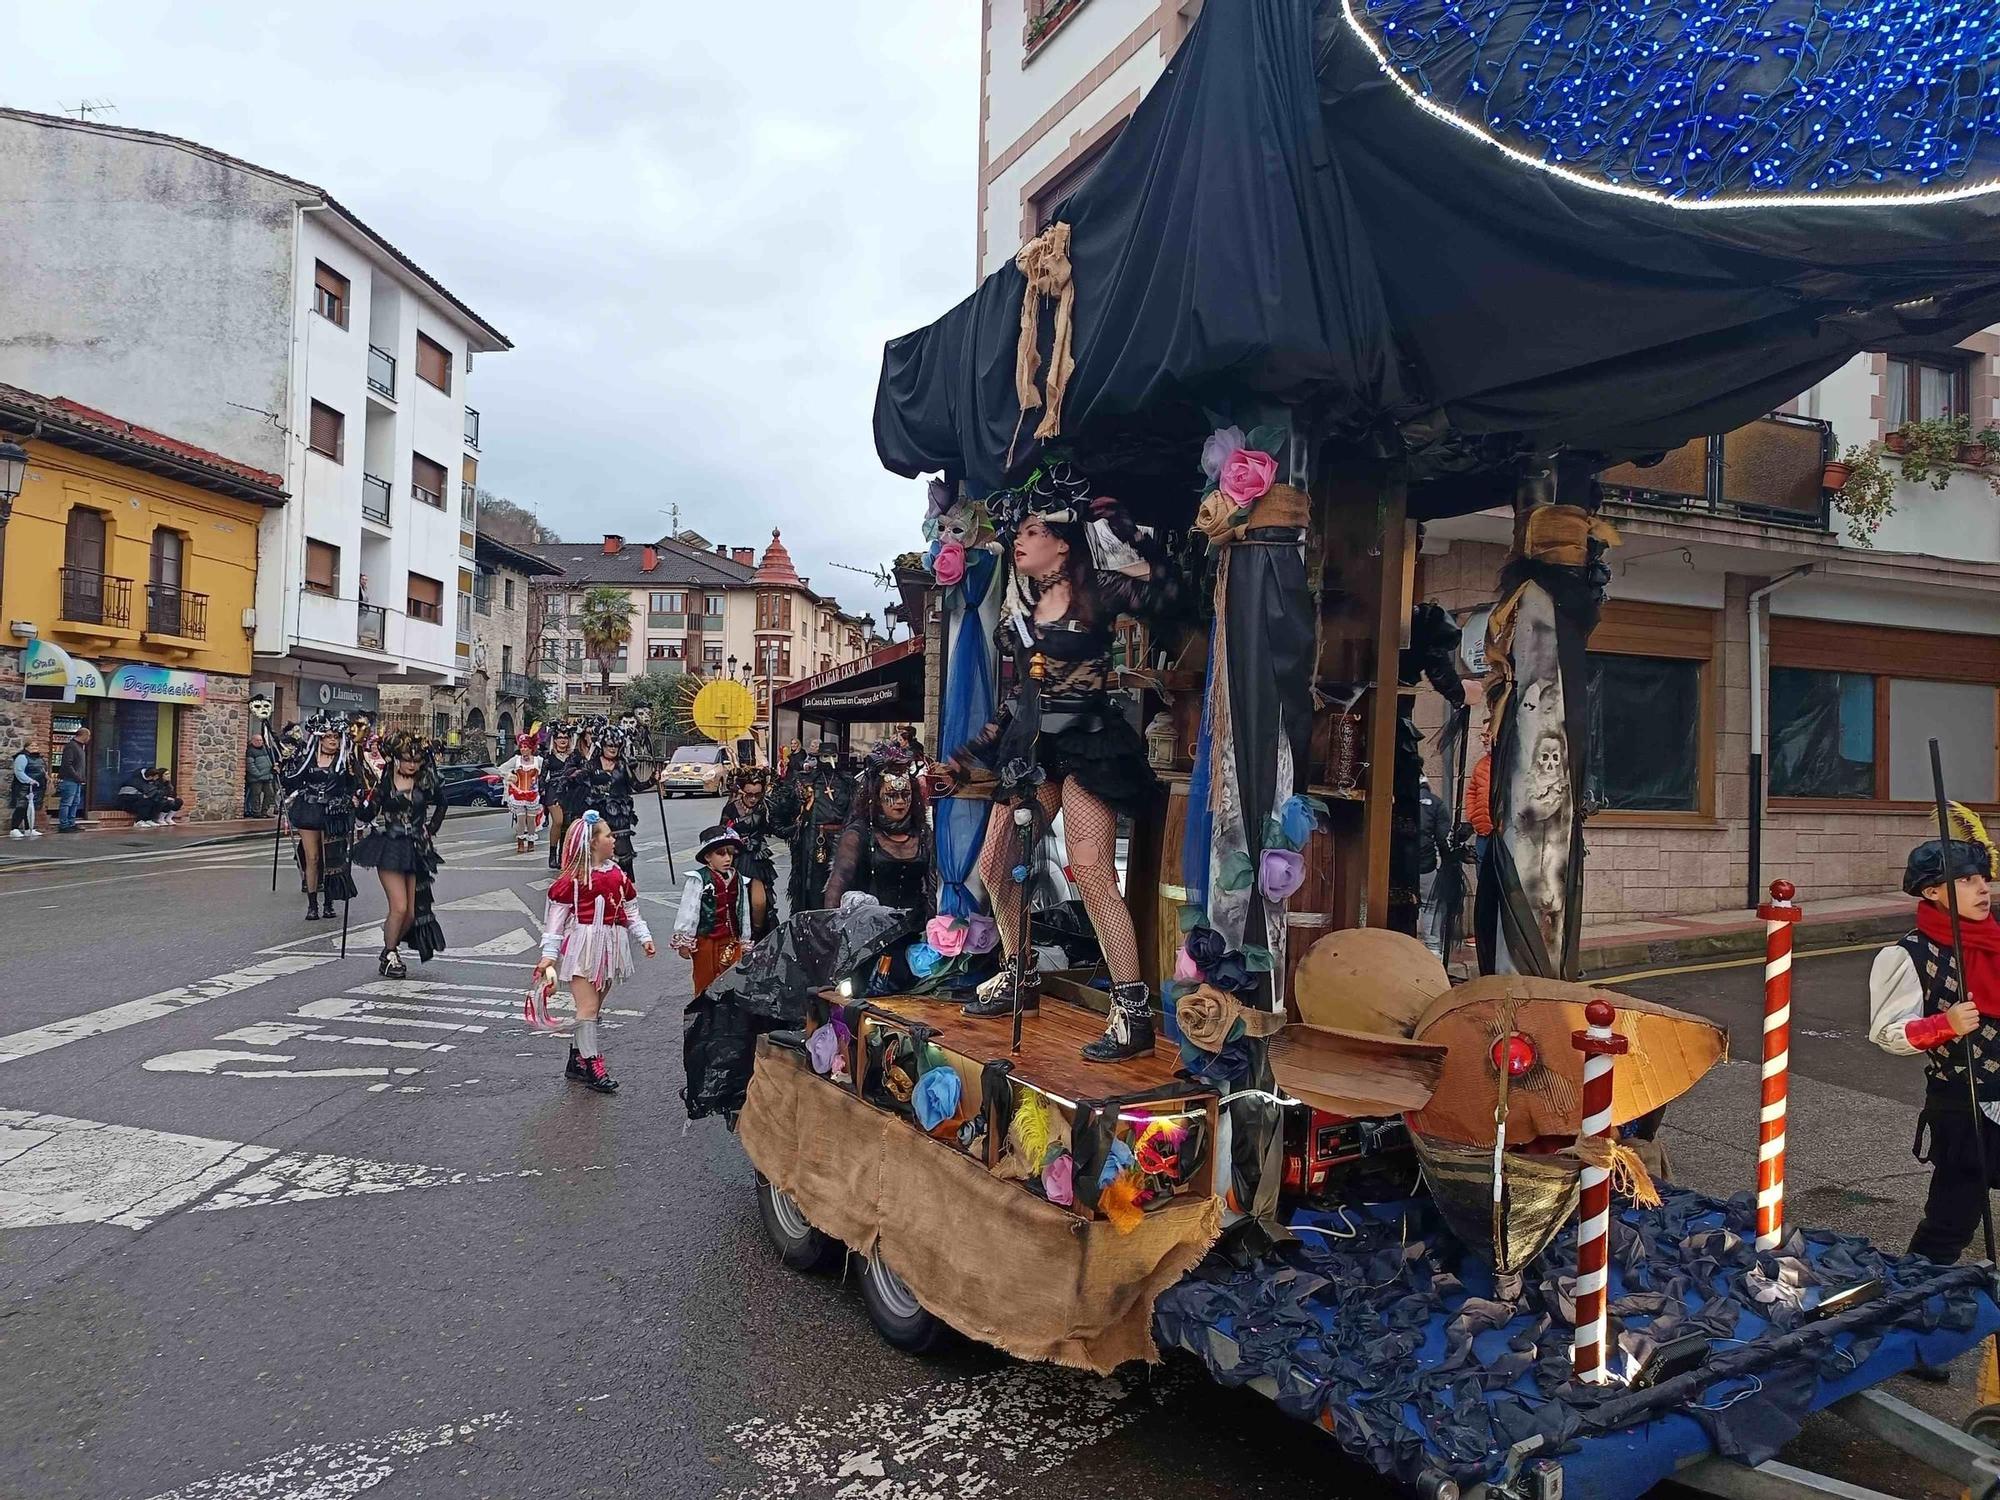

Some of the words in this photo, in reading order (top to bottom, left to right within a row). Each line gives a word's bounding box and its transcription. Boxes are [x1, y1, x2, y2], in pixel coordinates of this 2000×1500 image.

[810, 677, 819, 691] EL
[818, 668, 840, 688] LLAGAR
[841, 663, 856, 680] CASA
[858, 656, 873, 674] JUAN
[123, 674, 200, 698] Degustación
[805, 698, 811, 706] La
[812, 697, 823, 706] Casa
[823, 696, 831, 706] del
[847, 697, 854, 705] en
[854, 695, 873, 706] Cangas
[872, 693, 880, 701] de
